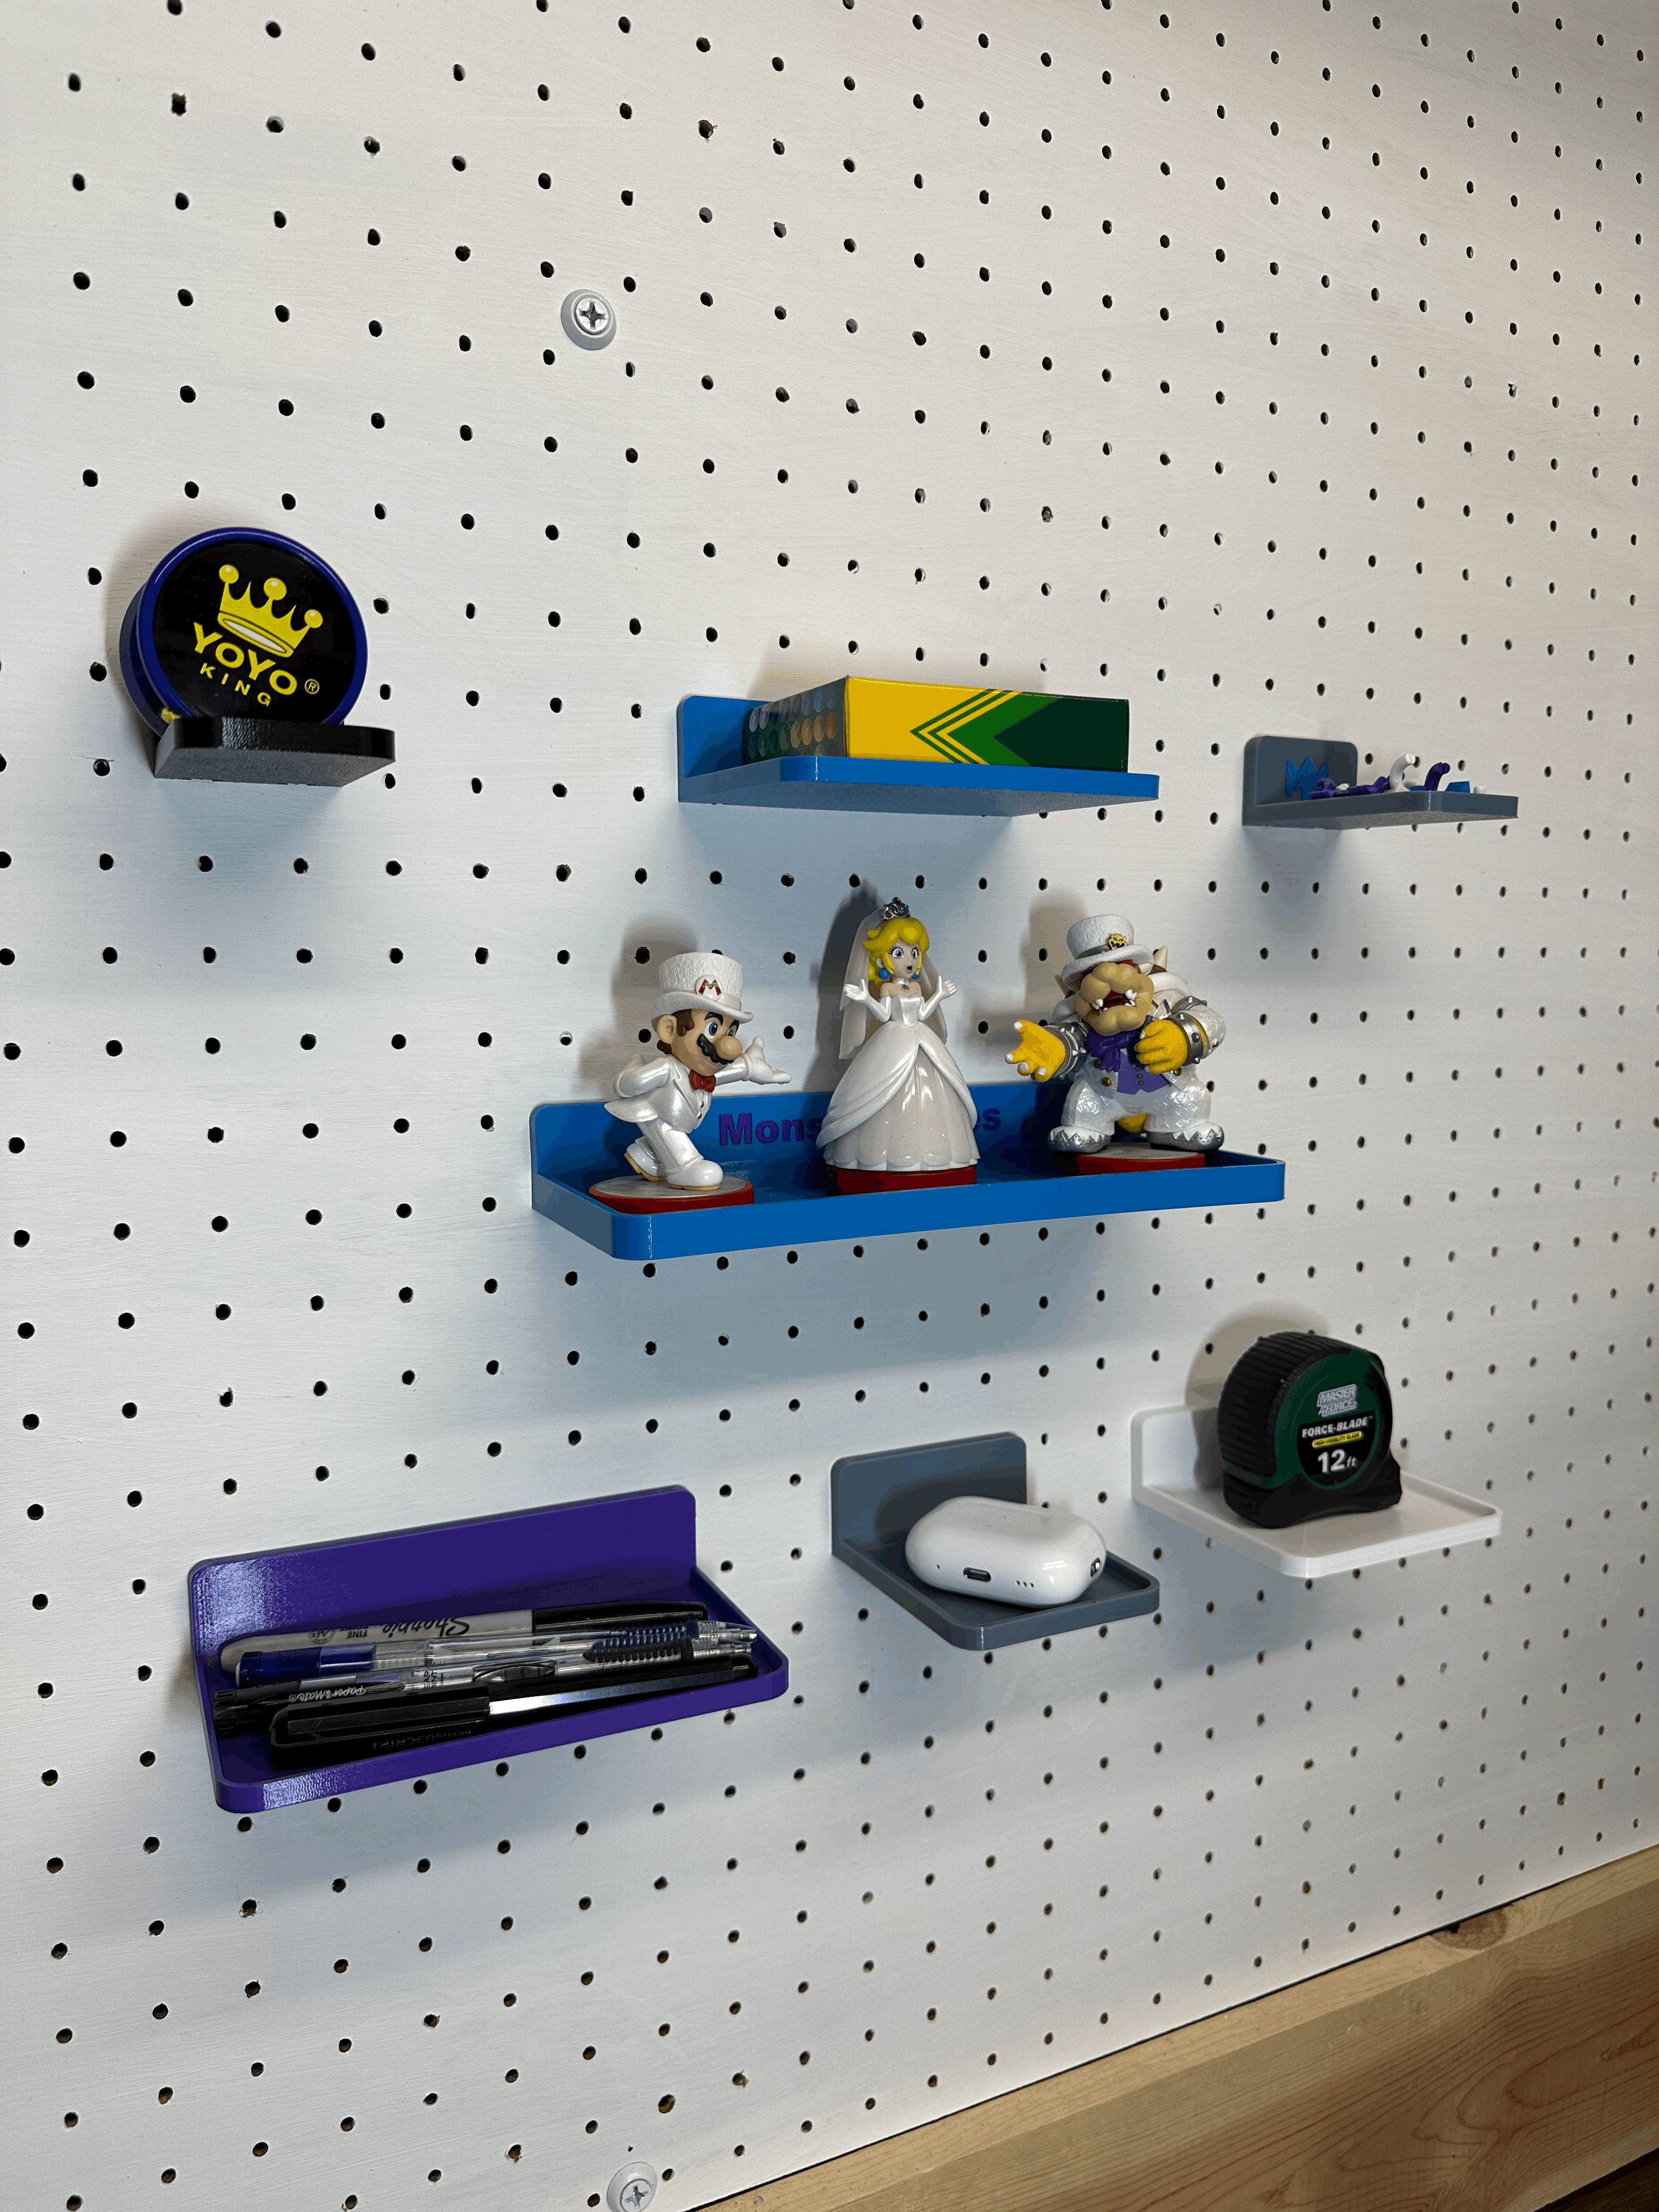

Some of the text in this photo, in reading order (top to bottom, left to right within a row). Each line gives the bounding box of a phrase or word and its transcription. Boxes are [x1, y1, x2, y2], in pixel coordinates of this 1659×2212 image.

[194, 622, 297, 695] YOYO
[200, 663, 272, 707] KING
[698, 979, 721, 996] M
[719, 1113, 823, 1146] Mons
[1319, 1386, 1355, 1404] MASTER
[1324, 1398, 1355, 1414] FORCE
[346, 1629, 368, 1639] FINE
